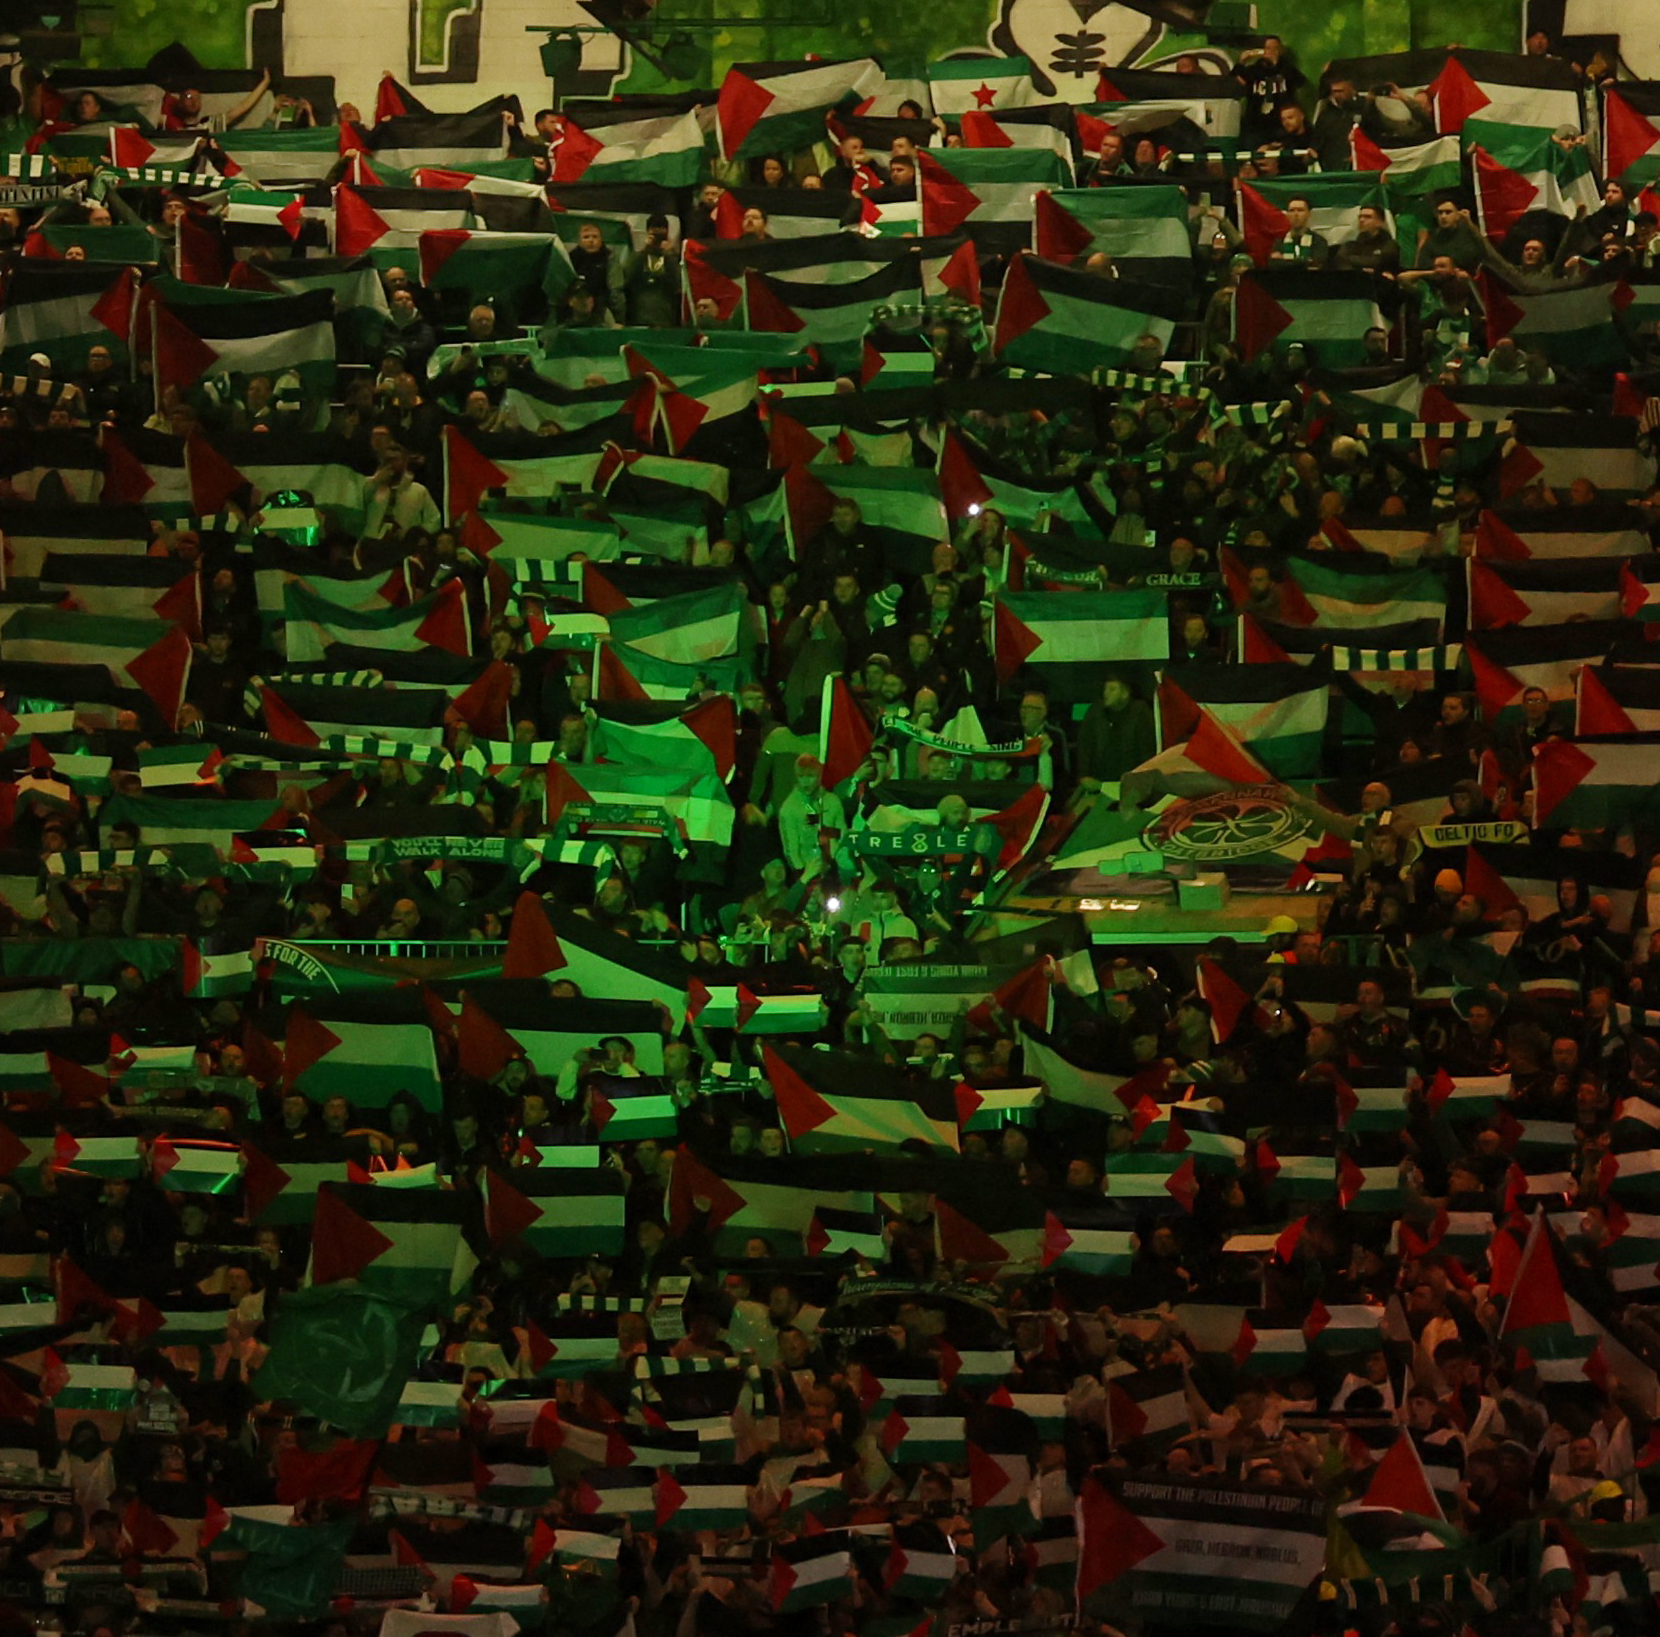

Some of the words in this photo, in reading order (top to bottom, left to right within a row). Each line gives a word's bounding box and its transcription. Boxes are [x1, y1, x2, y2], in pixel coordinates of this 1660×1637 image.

[1146, 572, 1202, 586] GRACE
[1435, 826, 1488, 842] CELTIC
[393, 846, 441, 857] WALK
[449, 847, 504, 859] ALONE
[274, 944, 298, 968] FOR
[297, 956, 323, 982] THE
[1123, 1480, 1172, 1501] SUPPORT
[1175, 1485, 1197, 1502] THE
[1199, 1489, 1266, 1510] PALESTINIAN
[1268, 1495, 1310, 1514] PEOPLE
